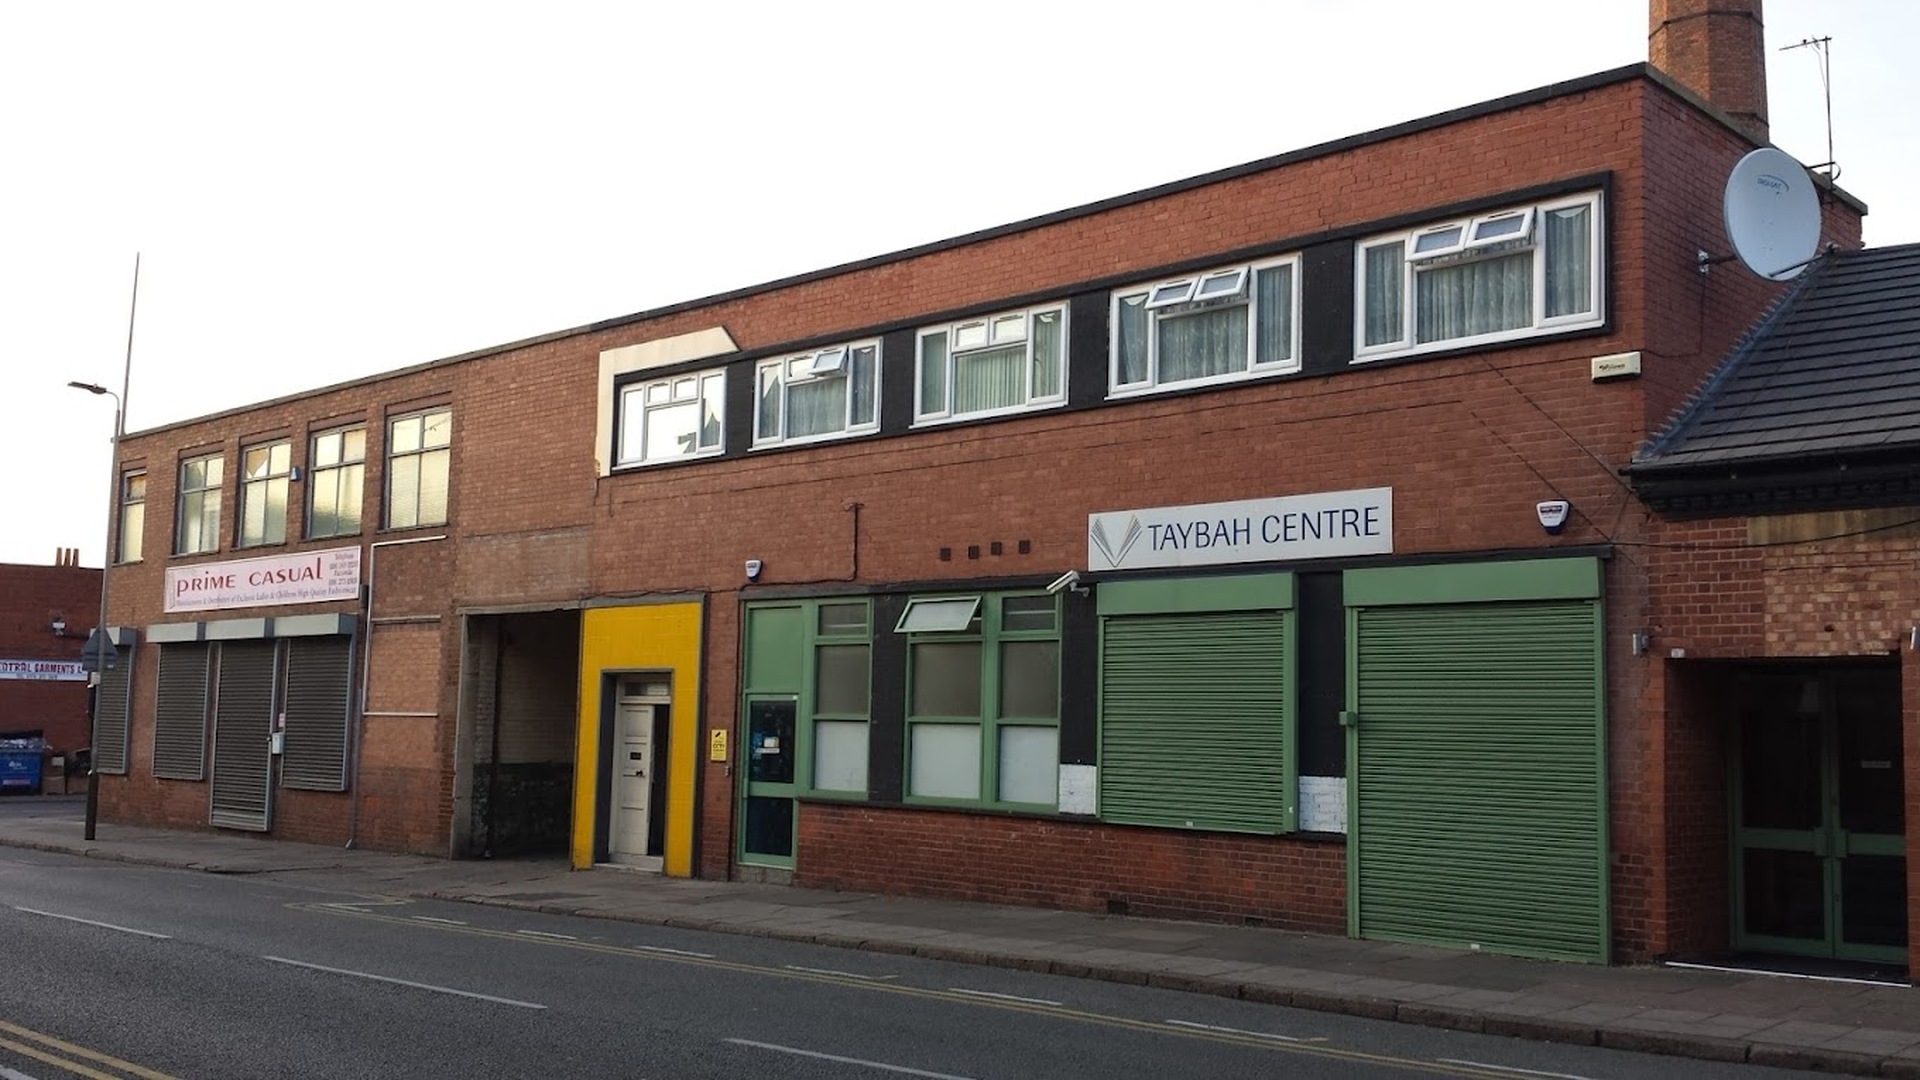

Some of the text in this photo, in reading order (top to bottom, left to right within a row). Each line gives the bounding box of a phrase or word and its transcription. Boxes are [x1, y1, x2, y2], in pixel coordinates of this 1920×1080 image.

[1148, 506, 1380, 551] TAYBAH CENTRE
[35, 663, 75, 674] GARMENTS
